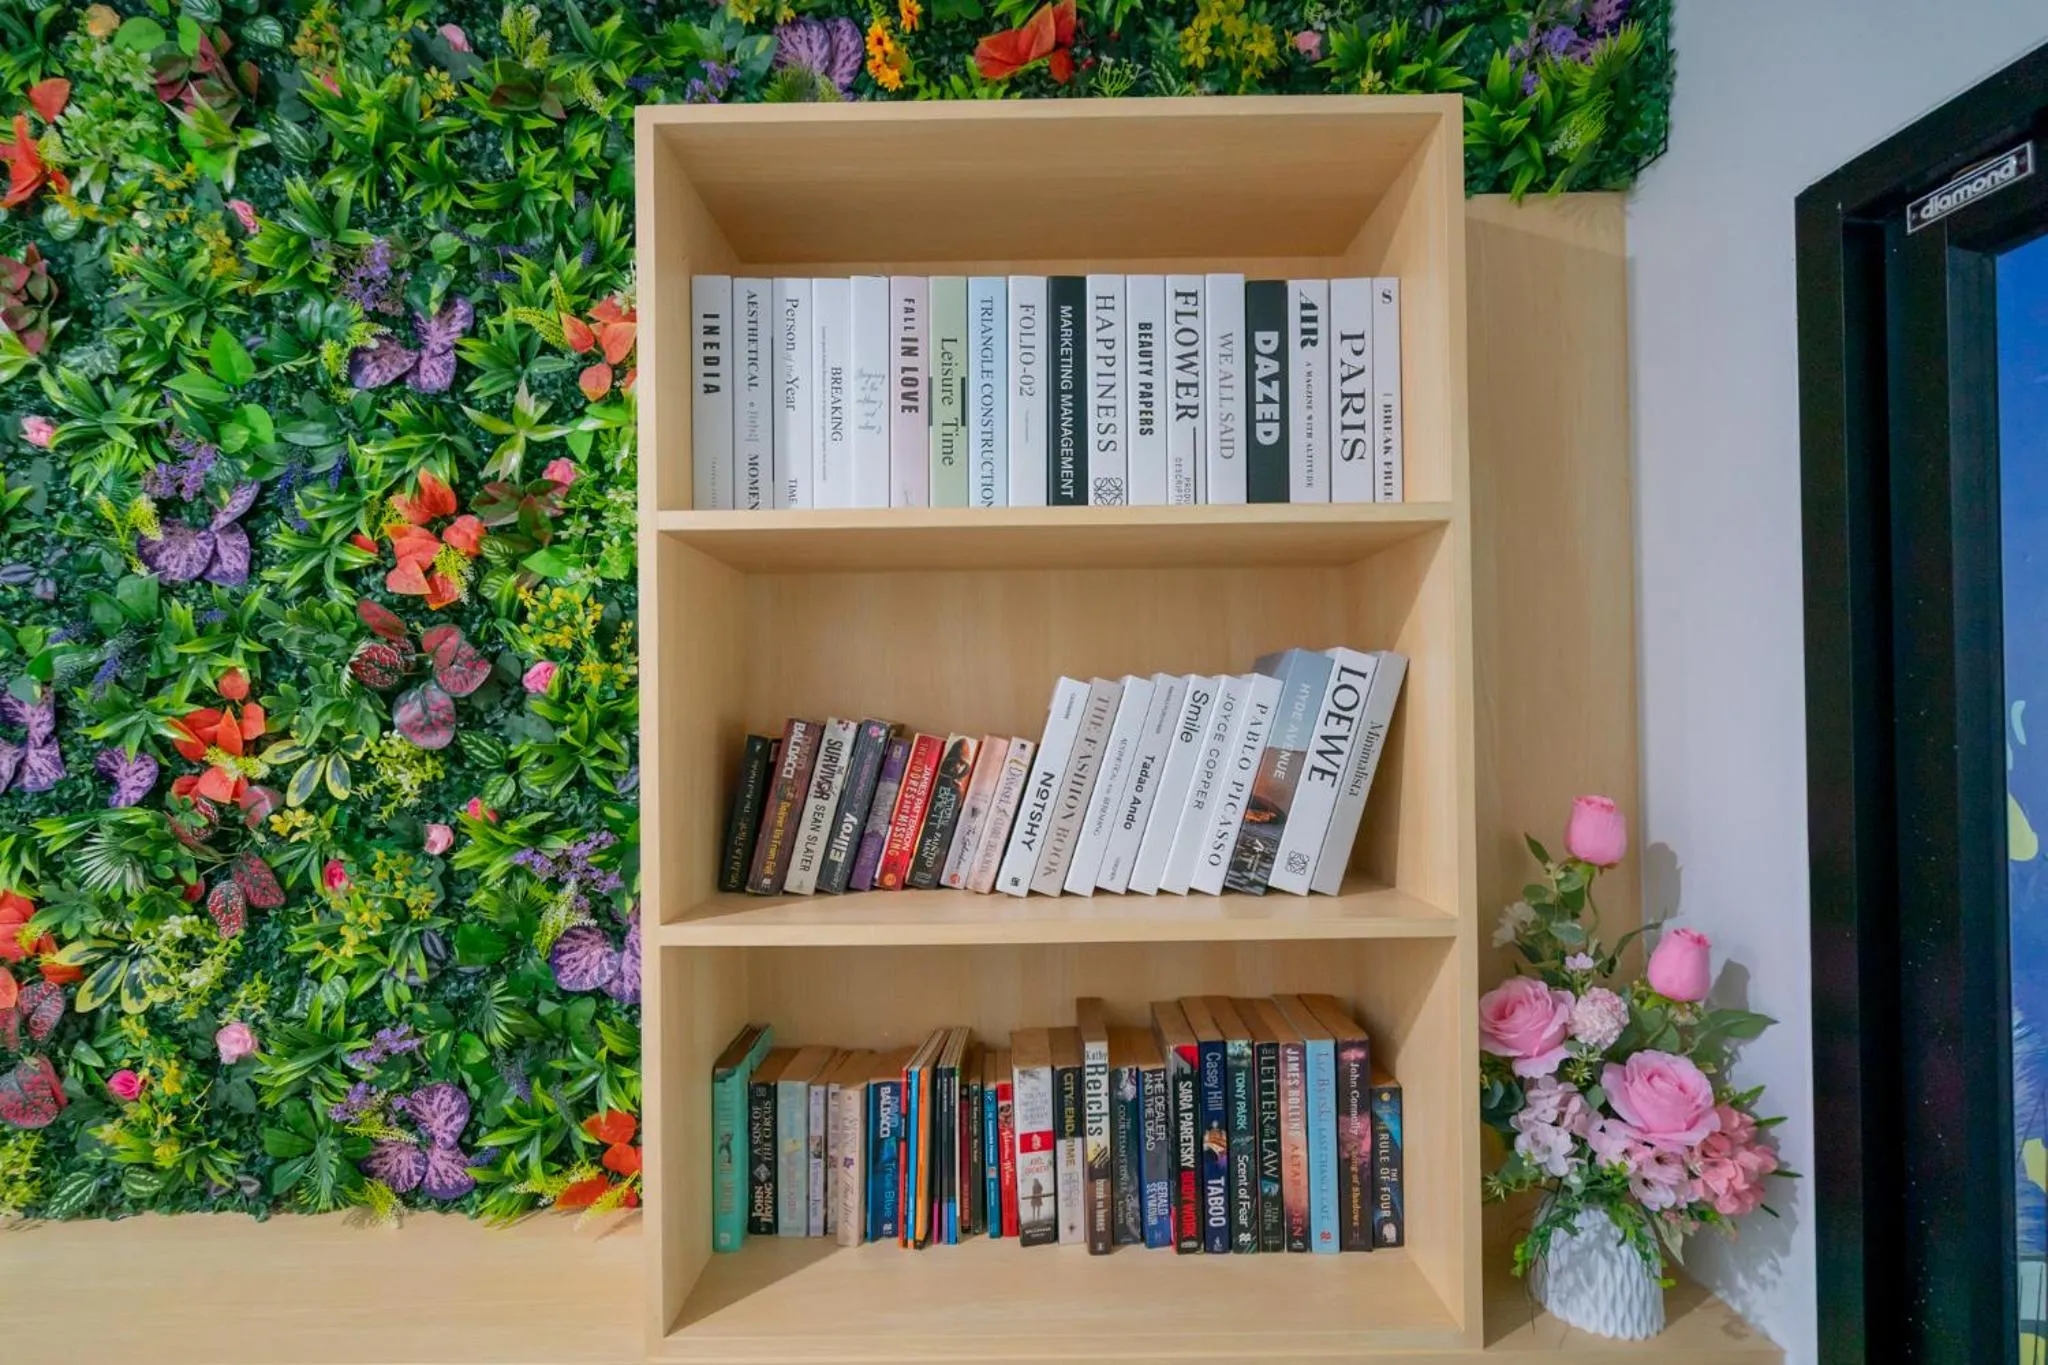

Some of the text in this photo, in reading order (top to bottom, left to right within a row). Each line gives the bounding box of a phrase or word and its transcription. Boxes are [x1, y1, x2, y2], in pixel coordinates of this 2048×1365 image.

[1920, 155, 2017, 219] diamond
[747, 290, 758, 392] AESTHETICAL
[785, 298, 800, 351] Person
[980, 296, 994, 378] TRIANGLE
[1018, 303, 1036, 397] FOLIO-02
[1300, 288, 1318, 350] AIR
[702, 313, 720, 394] INEDIA
[901, 298, 919, 414] FALL IN LOVE
[1096, 294, 1118, 453] HAPPINESS
[1138, 322, 1154, 436] BEAUTY PAPERS
[1174, 288, 1199, 422] FLOWER
[786, 376, 800, 412] Year
[831, 366, 843, 442] BREAKING
[940, 336, 958, 466] Leisure Time
[1060, 304, 1074, 498] MARKETING MANAGEMENT
[1218, 332, 1236, 460] WE ALL SAID
[1254, 330, 1280, 446] DAZED
[1340, 330, 1366, 463] PARIS
[1383, 404, 1393, 456] BREAK
[1089, 696, 1110, 733] THE
[1180, 690, 1210, 744] Smile
[1274, 683, 1311, 780] HYDE AVENUE
[1308, 665, 1366, 788] LOEWE
[782, 722, 806, 778] BALDACCI
[1061, 738, 1096, 820] FASHION
[1193, 692, 1236, 810] JOYCE COPPER
[1349, 721, 1384, 797] Minimalista
[798, 738, 842, 872] SURVIVOR SEAN SLATER
[902, 765, 930, 852] JAMES PATTERSON
[1123, 754, 1156, 830] Tadao Ando
[1208, 703, 1268, 866] PABLO PICASSO
[830, 812, 858, 864] Ellroy
[888, 814, 908, 857] MISSING
[1044, 827, 1070, 877] BOOK
[1064, 1072, 1074, 1099] CITY
[1204, 1051, 1224, 1110] Casey Hill
[1260, 1055, 1278, 1123] LETTER
[1287, 1047, 1301, 1086] JAMES
[1348, 1062, 1362, 1135] John Connolly
[761, 1100, 770, 1138] CIRCUS
[1065, 1107, 1076, 1131] END
[1086, 1063, 1109, 1136] Reichs
[1144, 1072, 1156, 1150] AND THE DEAD
[1154, 1071, 1166, 1141] THE DEALER
[1234, 1070, 1248, 1130] TONY PARK
[1288, 1089, 1302, 1137] ROLLINS
[752, 1122, 761, 1144] SON
[752, 1146, 761, 1155] A
[1066, 1138, 1077, 1166] TIME
[1180, 1080, 1196, 1237] SARA PARETSKY BODY WORK
[1263, 1138, 1279, 1178] LAW
[1380, 1133, 1390, 1162] RULE
[750, 1185, 762, 1216] JOHN
[760, 1182, 772, 1222] IRVING
[884, 1161, 896, 1216] True Blue
[1147, 1182, 1159, 1225] SEYMOUR
[1158, 1181, 1169, 1215] GERALD
[1208, 1176, 1227, 1227] TABOO
[1238, 1154, 1251, 1227] Scent of Fear
[1381, 1167, 1390, 1180] OF
[1381, 1186, 1391, 1217] FOUR
